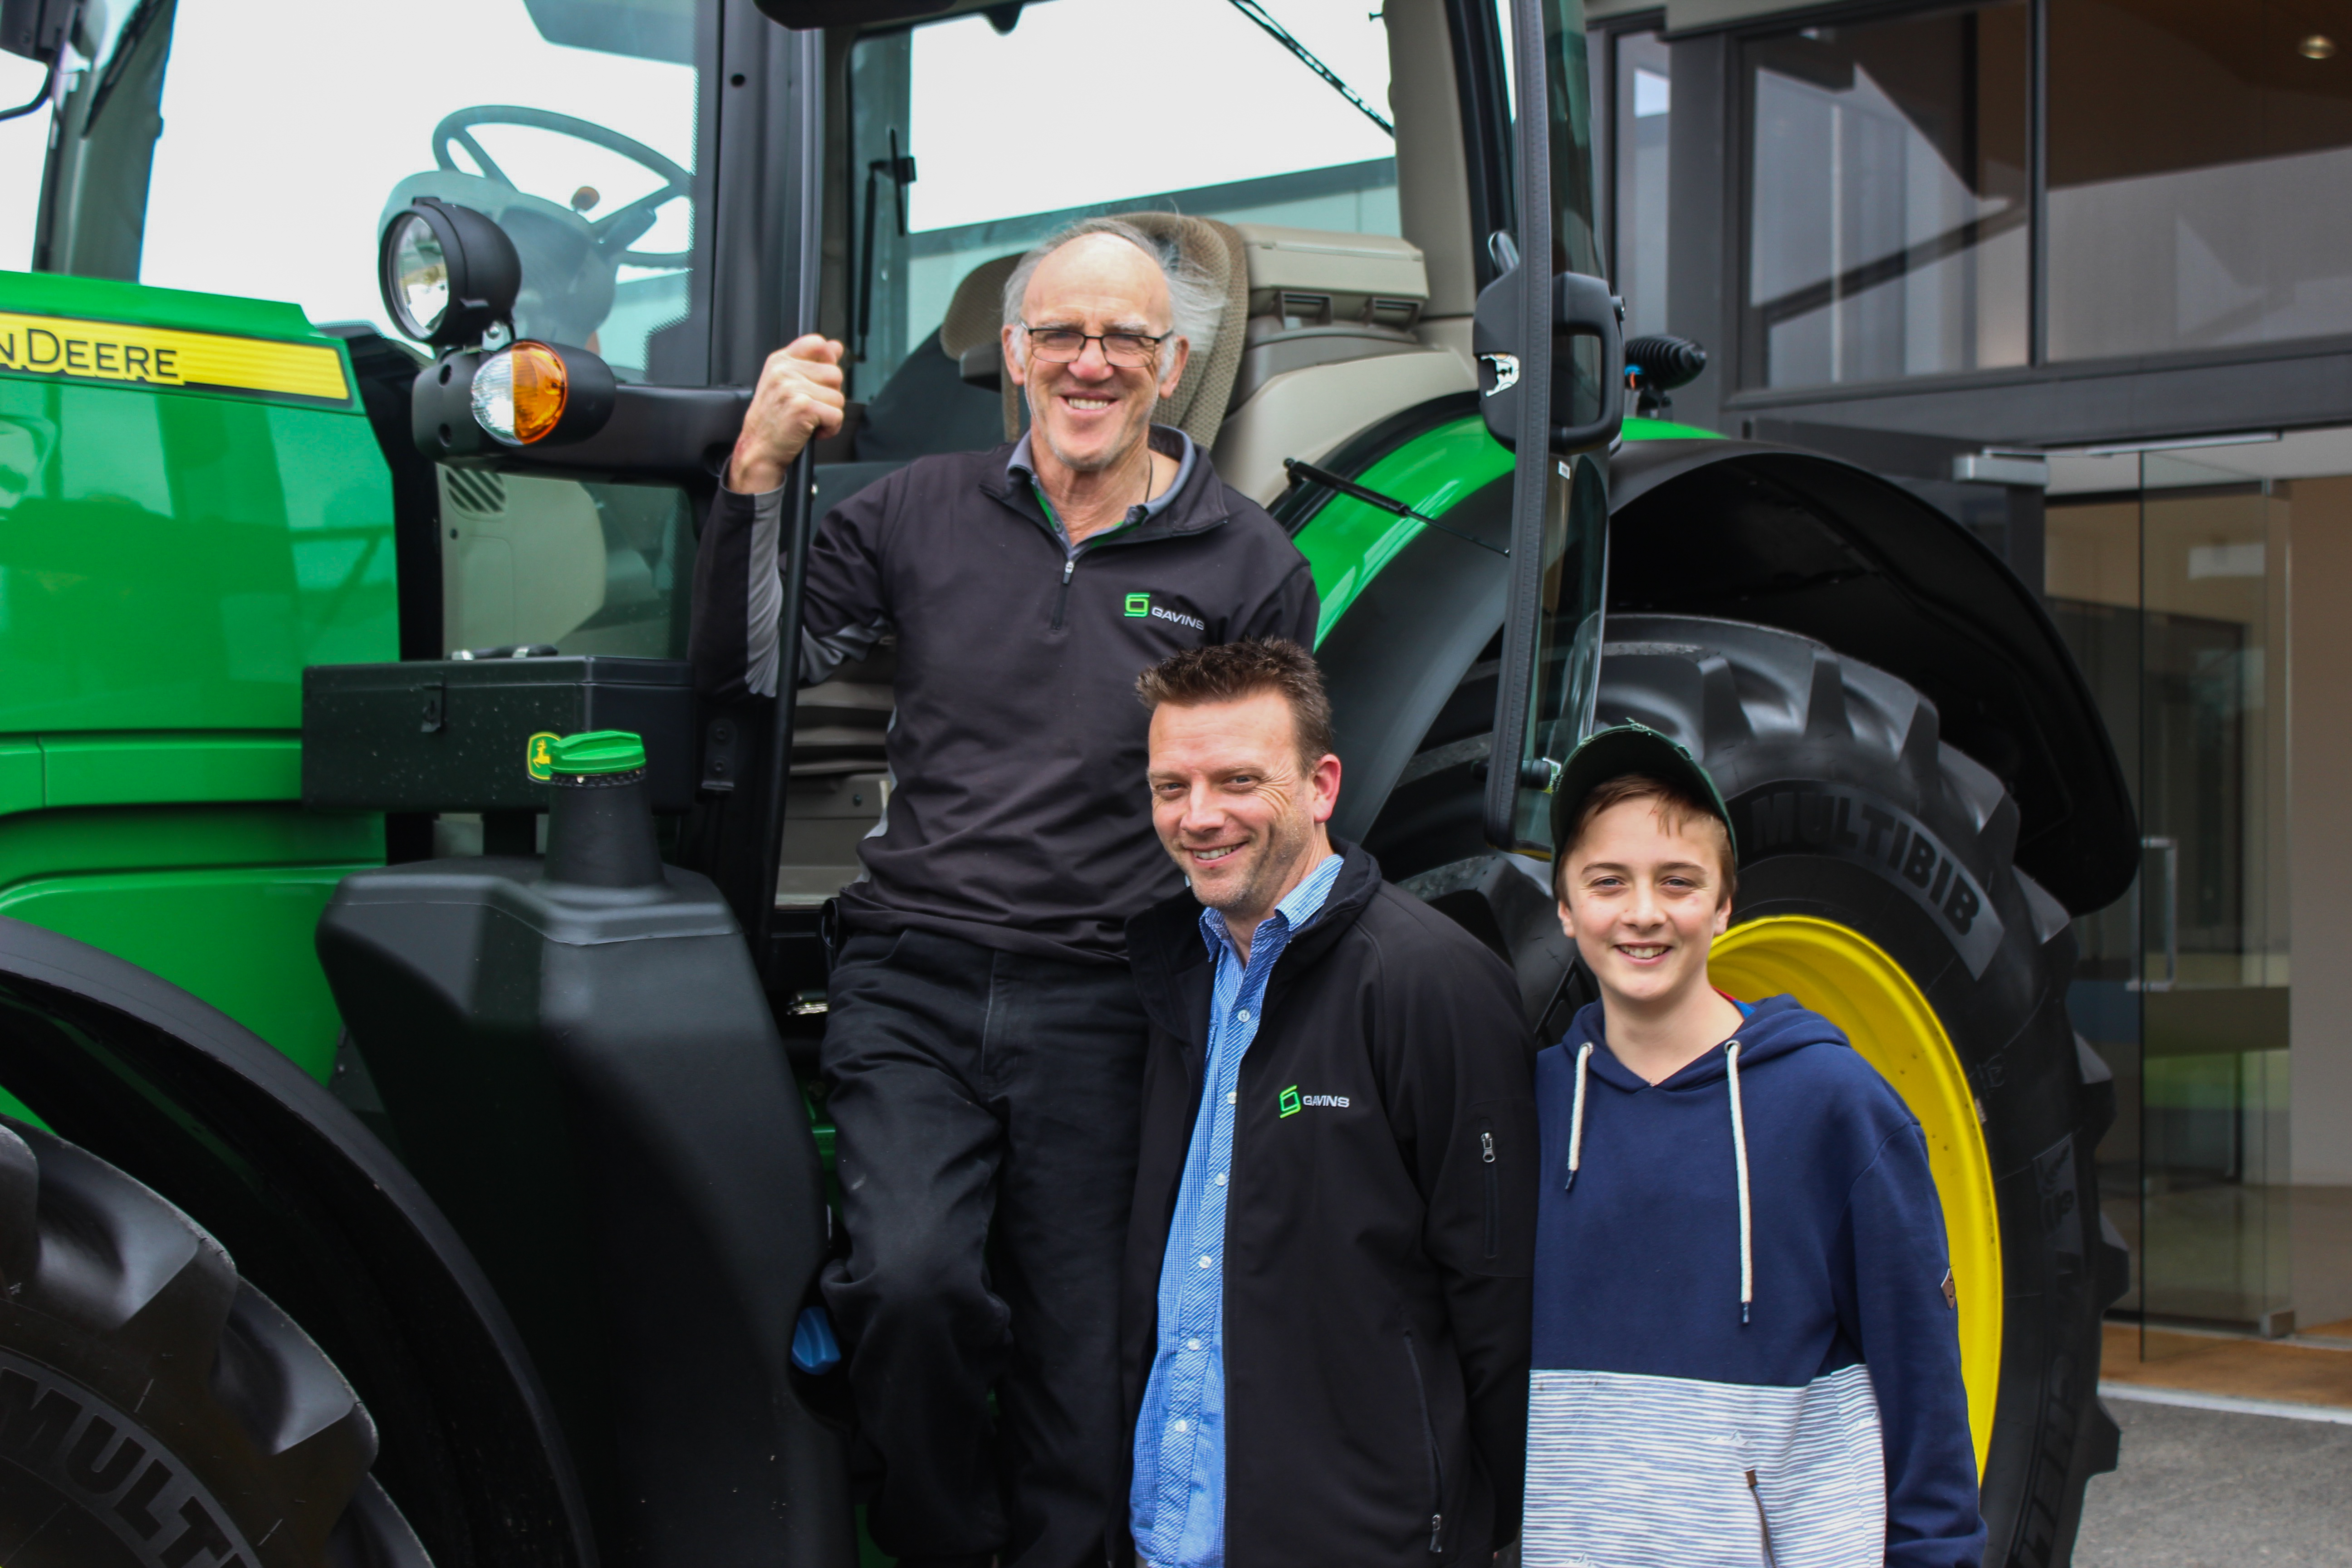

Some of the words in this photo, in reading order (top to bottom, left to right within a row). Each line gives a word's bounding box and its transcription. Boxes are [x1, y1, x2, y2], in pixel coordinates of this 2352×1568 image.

[27, 328, 178, 377] DEERE
[1152, 606, 1205, 631] GAVINS
[1750, 791, 1980, 936] MULTIBIB
[1303, 1095, 1349, 1108] GAVINS
[0, 1368, 248, 1568] MULT
